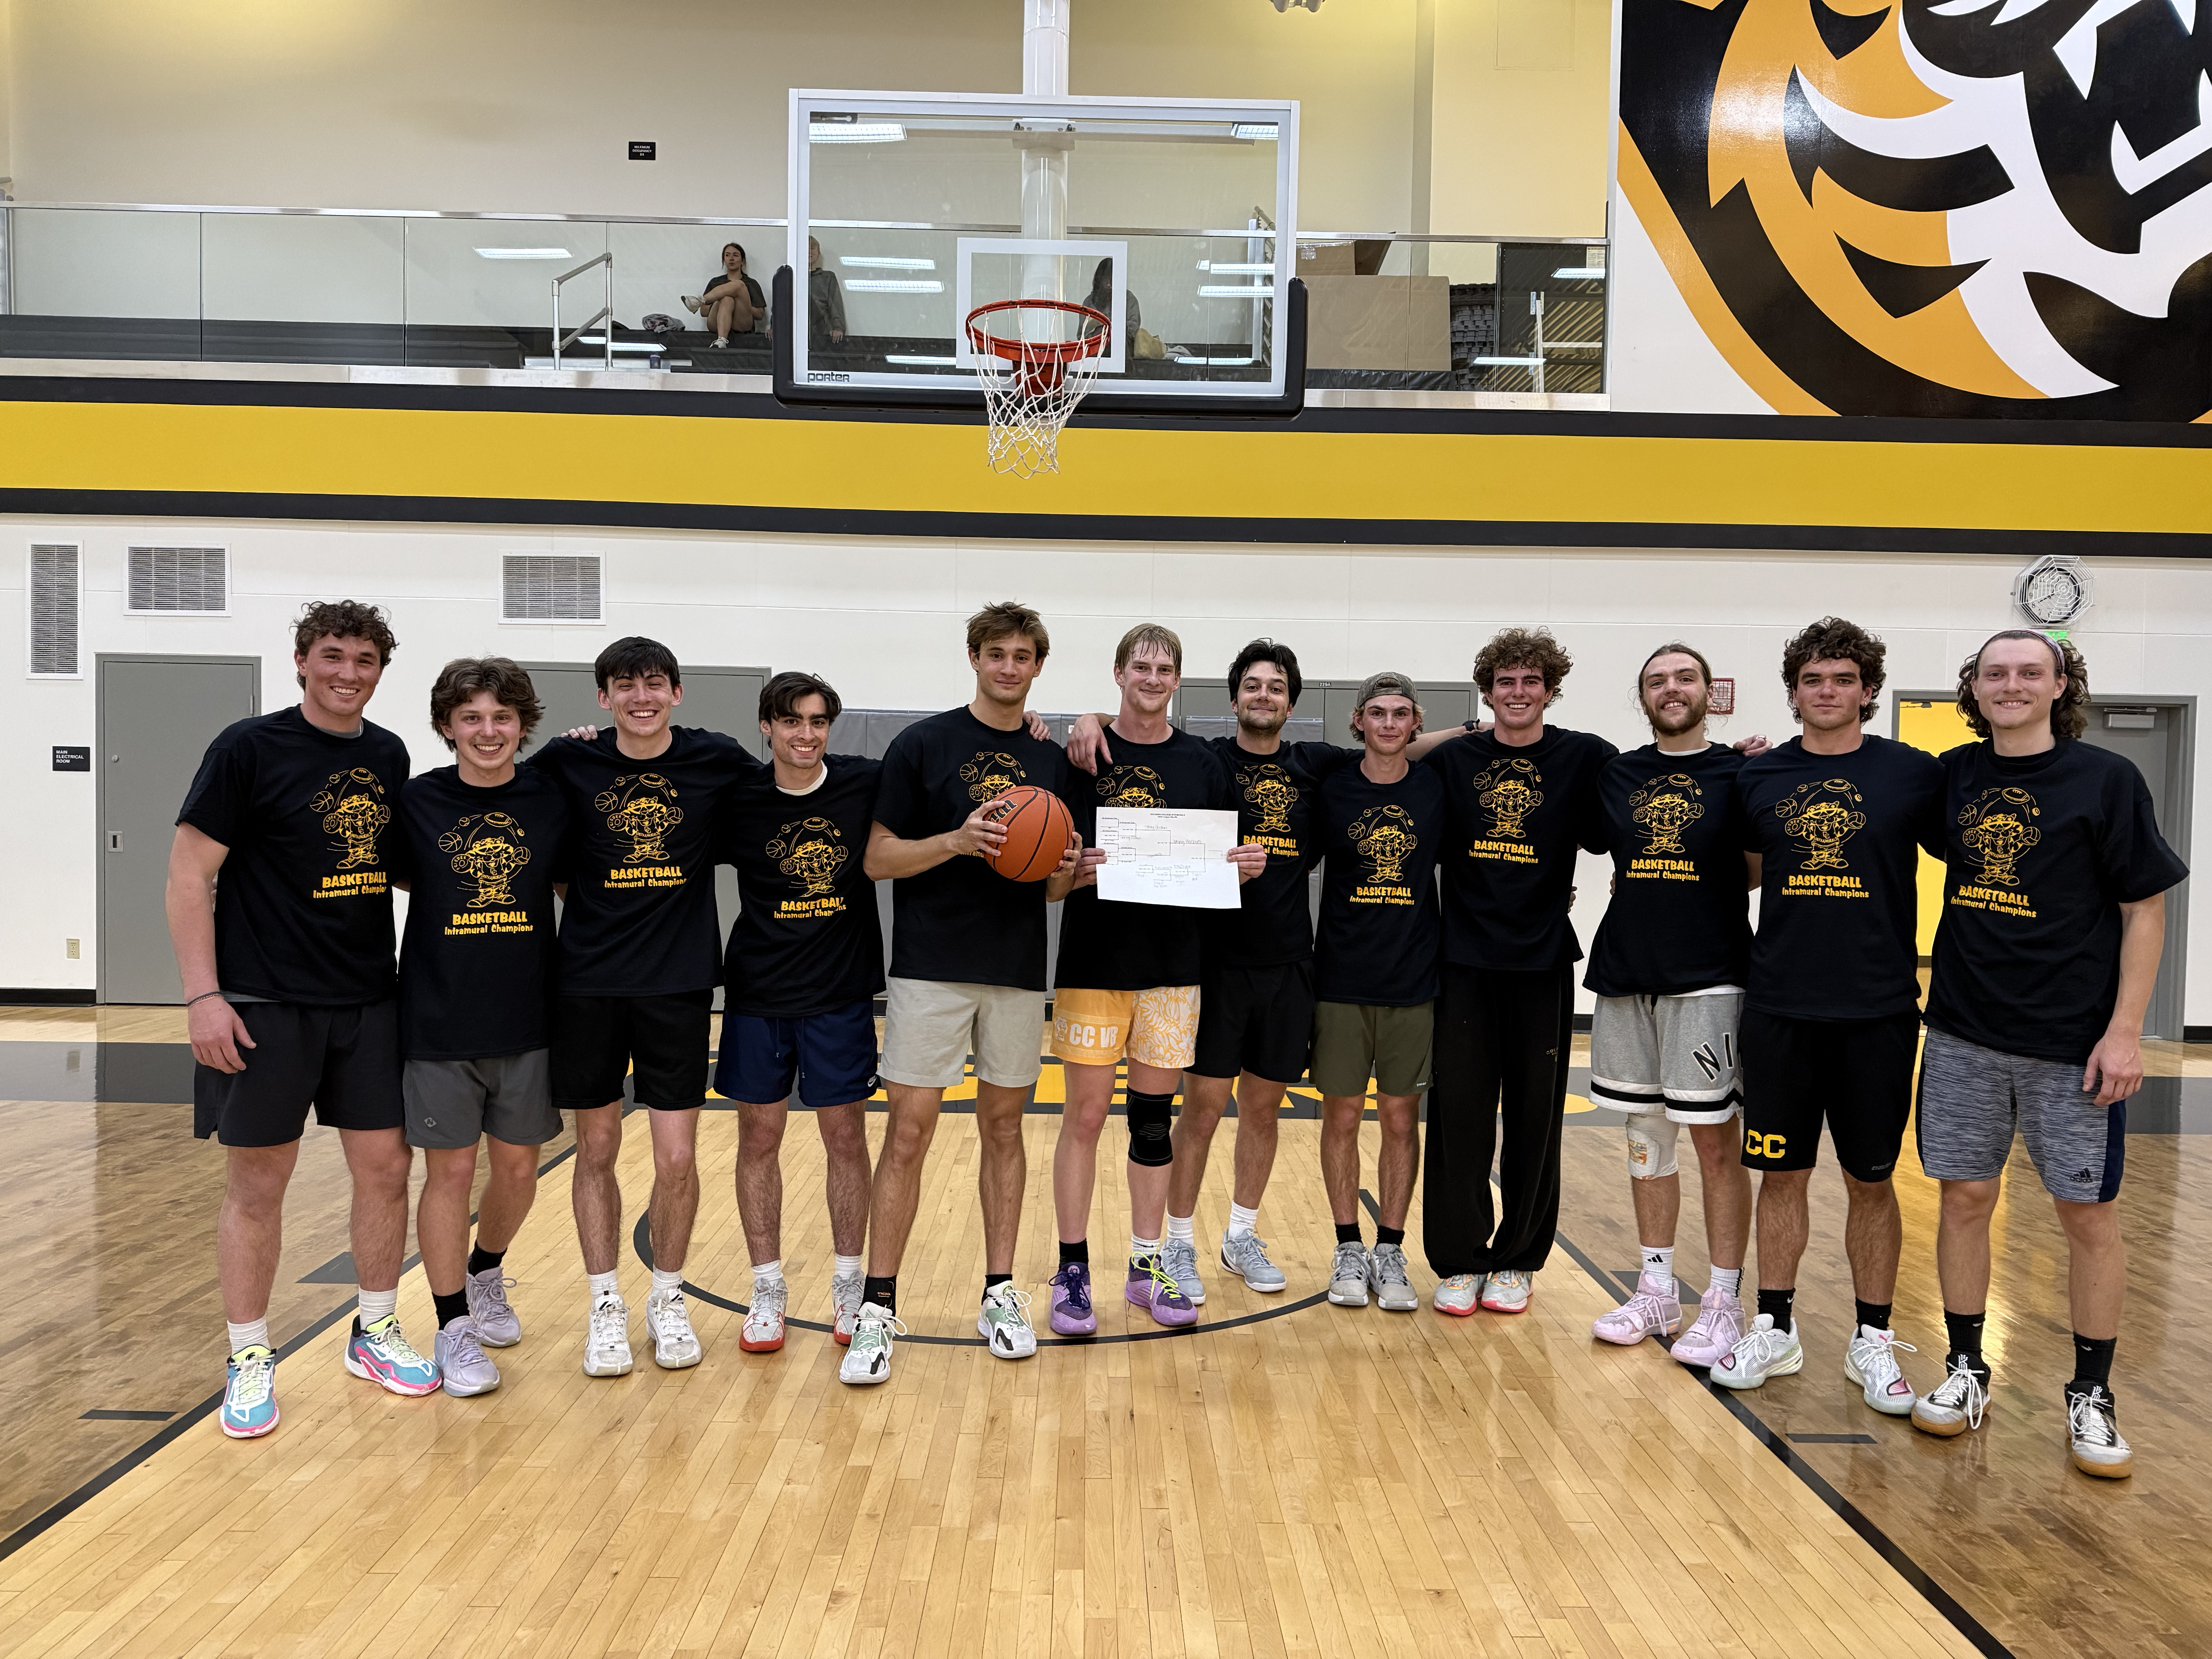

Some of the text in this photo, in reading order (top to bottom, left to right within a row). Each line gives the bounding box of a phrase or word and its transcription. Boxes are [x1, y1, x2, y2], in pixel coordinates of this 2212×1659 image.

[1243, 835, 1296, 848] BASKETBALL
[1474, 840, 1534, 855] BASKETBALL
[1273, 847, 1298, 857] Champions
[1469, 850, 1538, 863] Intramural Champions
[1632, 859, 1694, 872] BASKETBALL
[611, 867, 682, 879] BASKETBALL
[1663, 871, 1699, 881] Champions
[323, 872, 386, 888] BASKETBALL
[605, 879, 644, 888] Intramural
[1789, 875, 1861, 888] BASKETBALL
[313, 885, 386, 898] Intramural Champio
[1357, 887, 1411, 897] BASKETBALL
[1782, 887, 1869, 898] Intramural Champions
[1959, 885, 2029, 906] BASKETBALL
[1385, 897, 1414, 905] Champions
[1951, 896, 2036, 917] Intramural Champions
[453, 911, 527, 925] BASKETBALL
[445, 924, 533, 935] Intramural Champions
[1069, 1023, 1118, 1048] CC VB
[1746, 1129, 1786, 1158] CC
